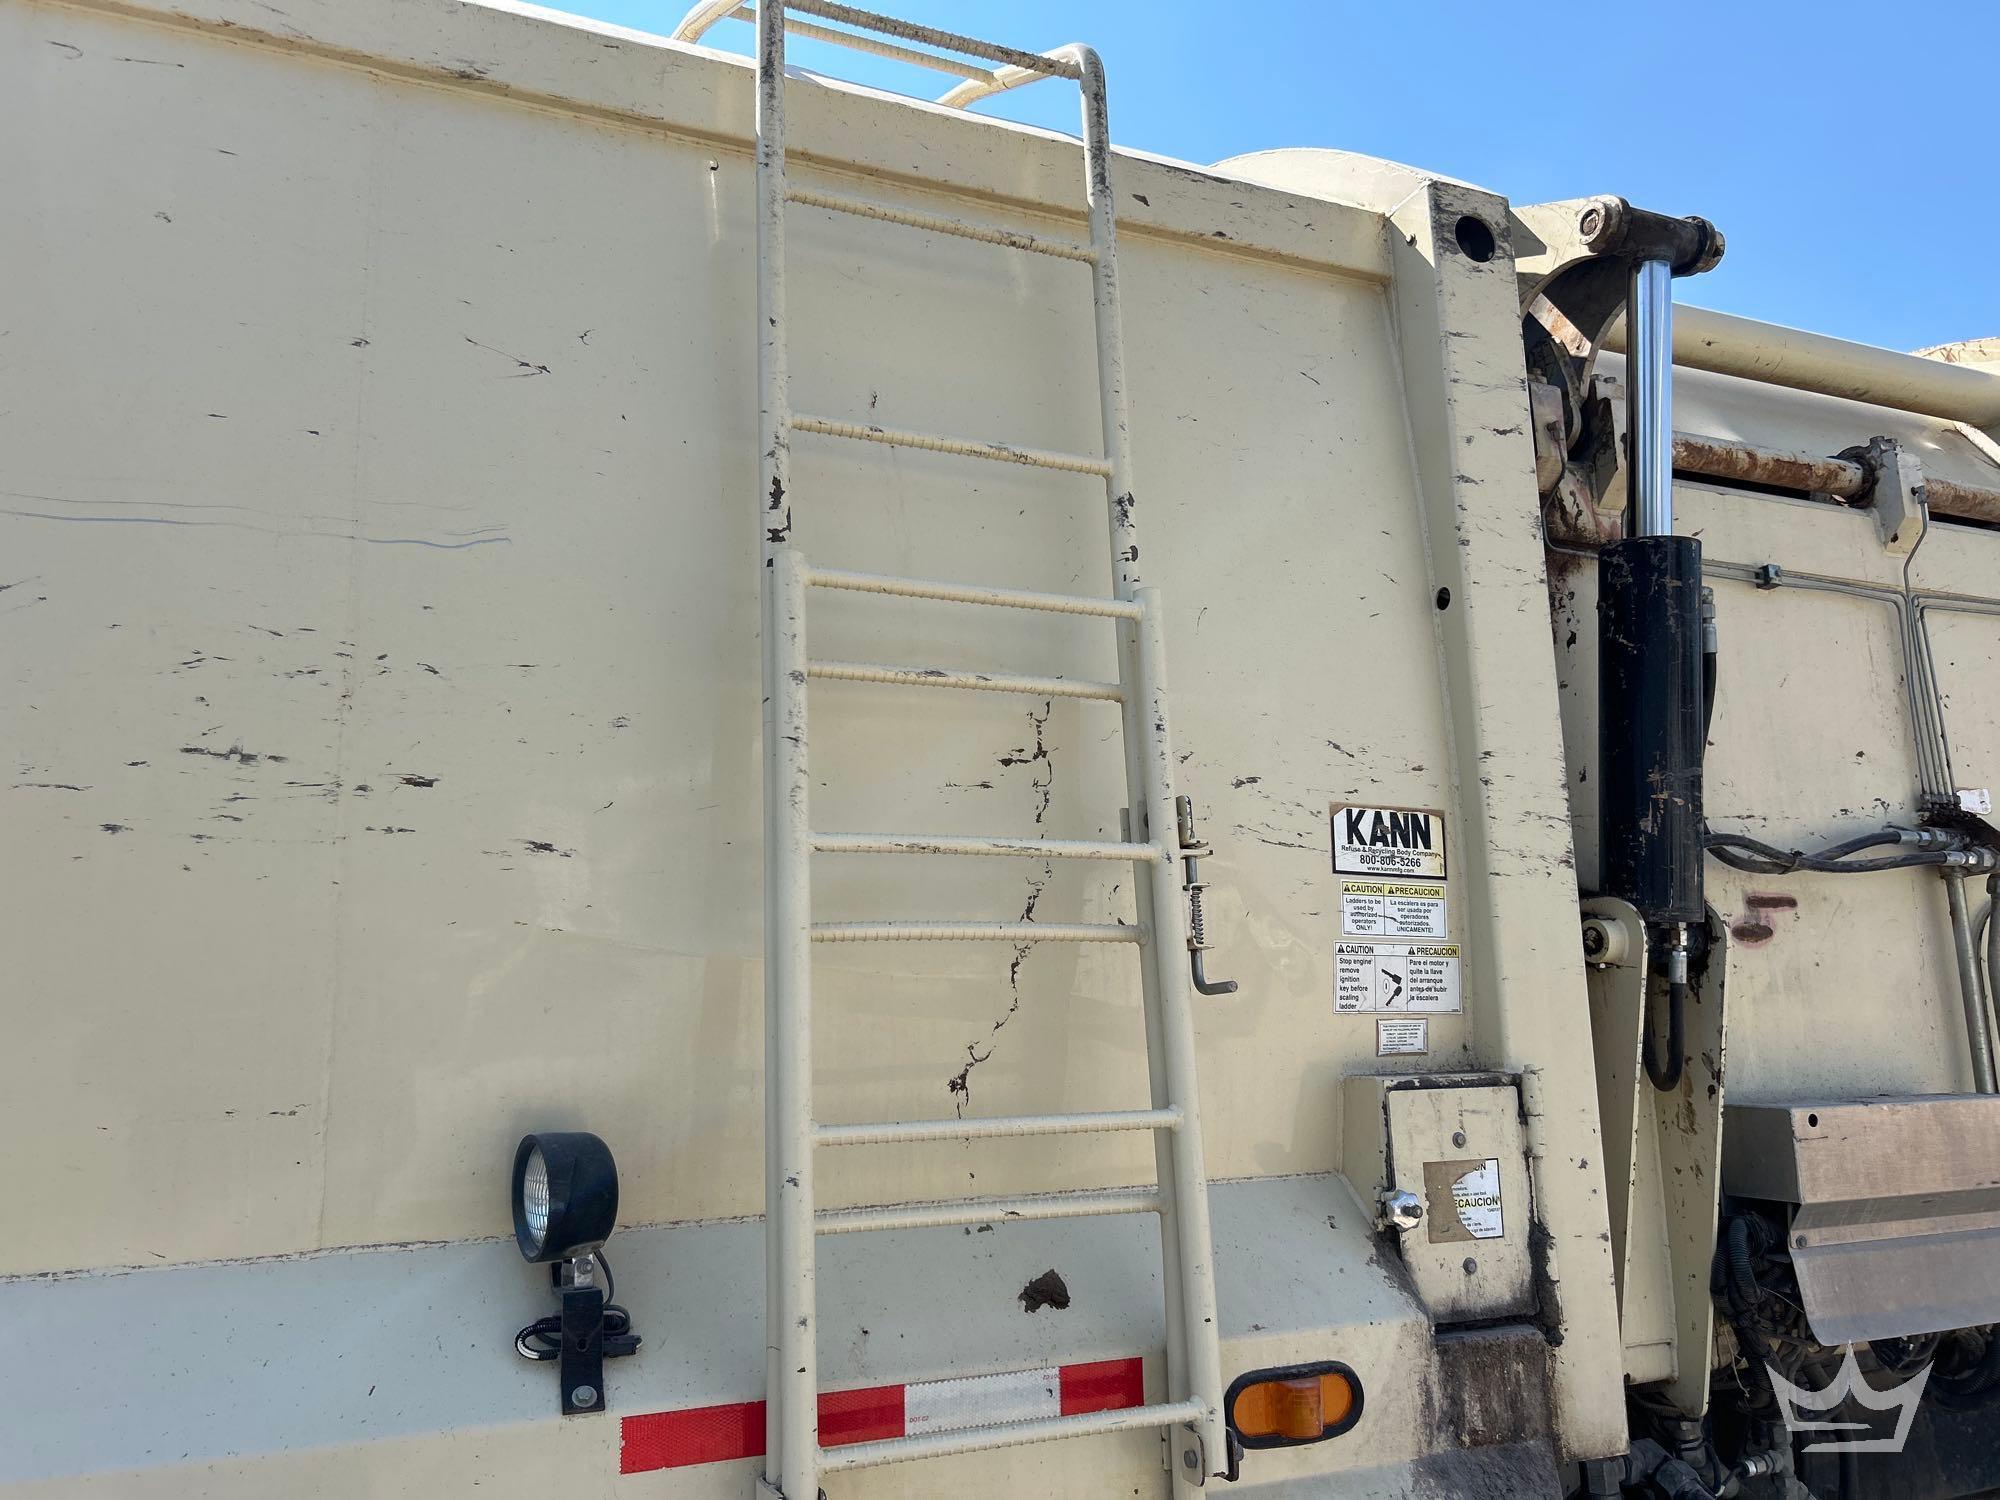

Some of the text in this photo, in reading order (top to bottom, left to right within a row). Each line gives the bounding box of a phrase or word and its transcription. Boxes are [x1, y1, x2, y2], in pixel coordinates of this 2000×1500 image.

[1346, 809, 1431, 850] KANN
[1368, 847, 1395, 857] Recycling
[1360, 855, 1421, 867] 800-806-5266
[1395, 887, 1439, 896] PRECAUCION
[1416, 947, 1456, 955] PRECAUCION
